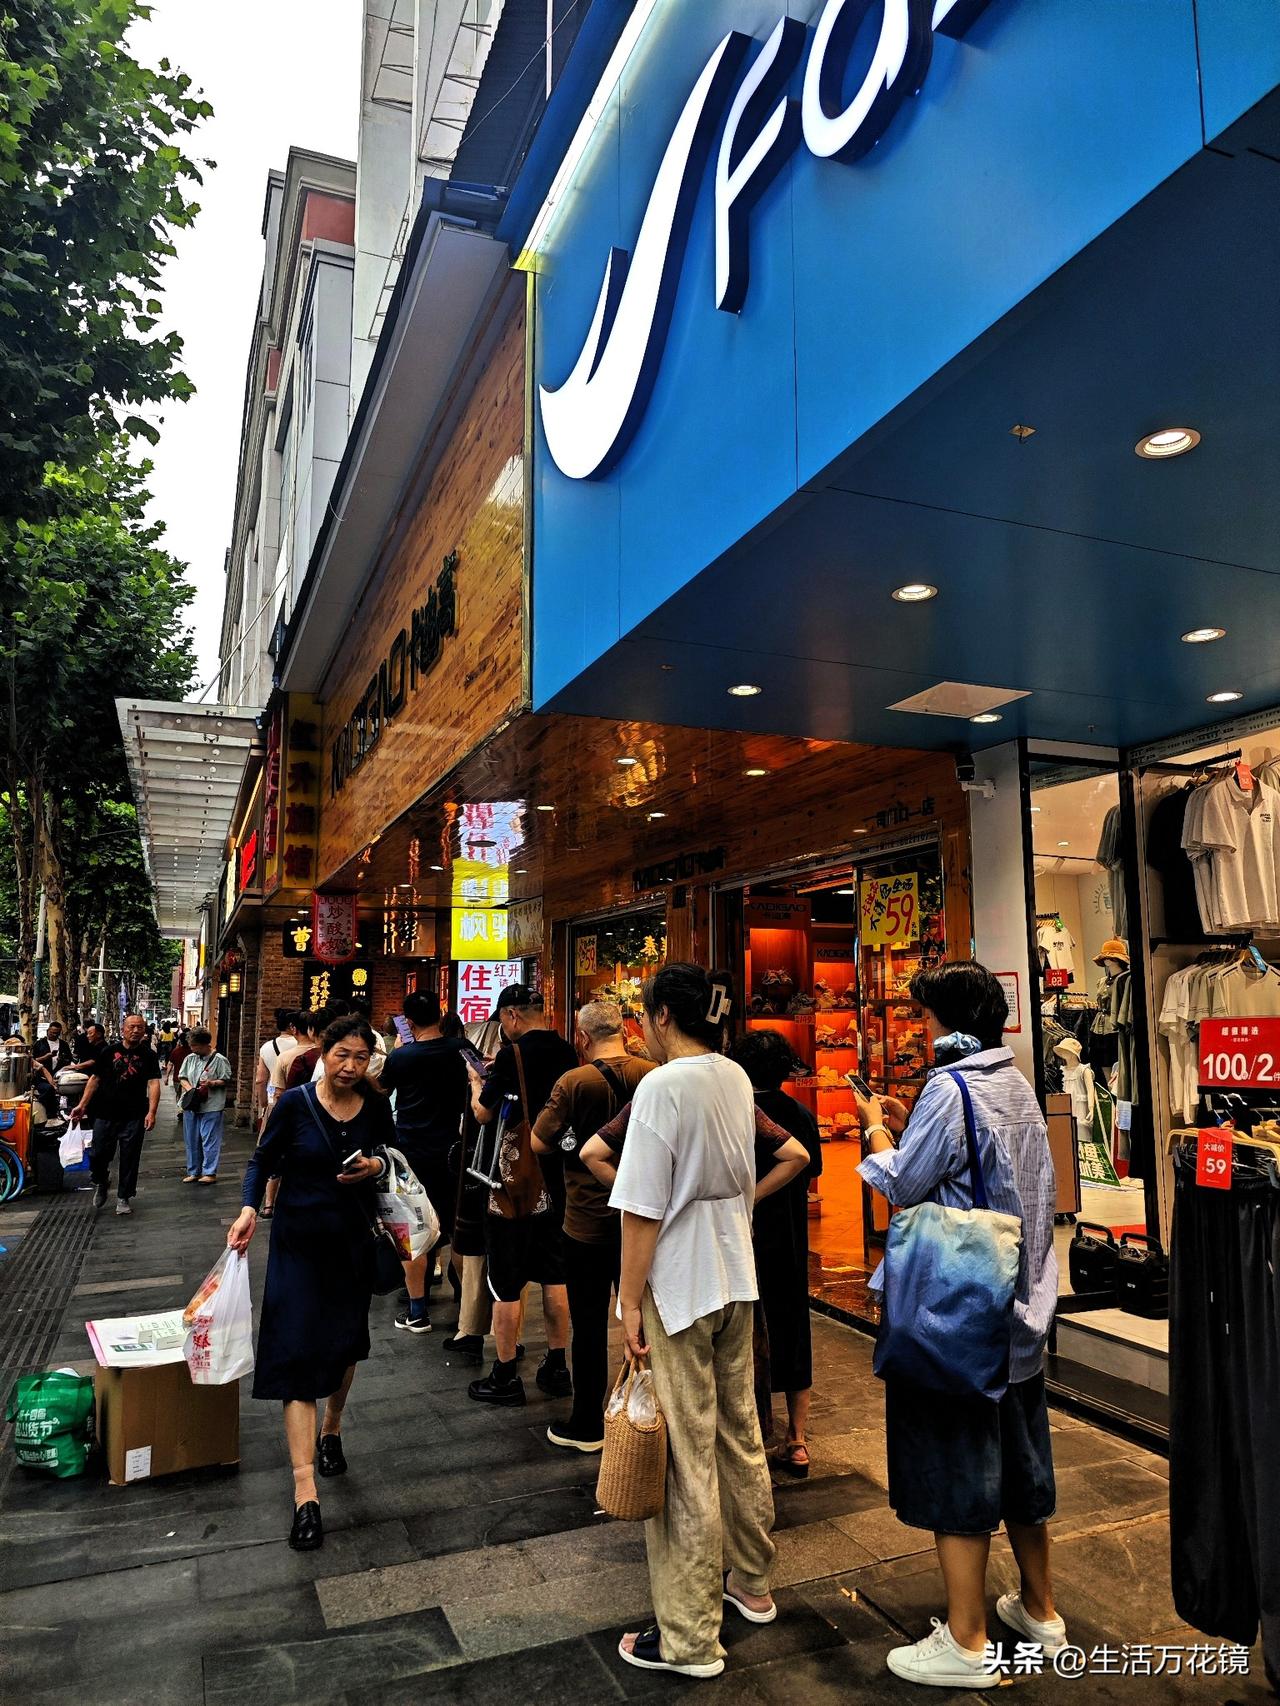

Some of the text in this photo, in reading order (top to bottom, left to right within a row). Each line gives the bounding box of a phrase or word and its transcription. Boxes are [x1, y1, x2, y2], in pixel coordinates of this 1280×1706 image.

[885, 893, 914, 936] 59
[493, 963, 519, 978] 红升
[459, 964, 492, 1023] 住宿
